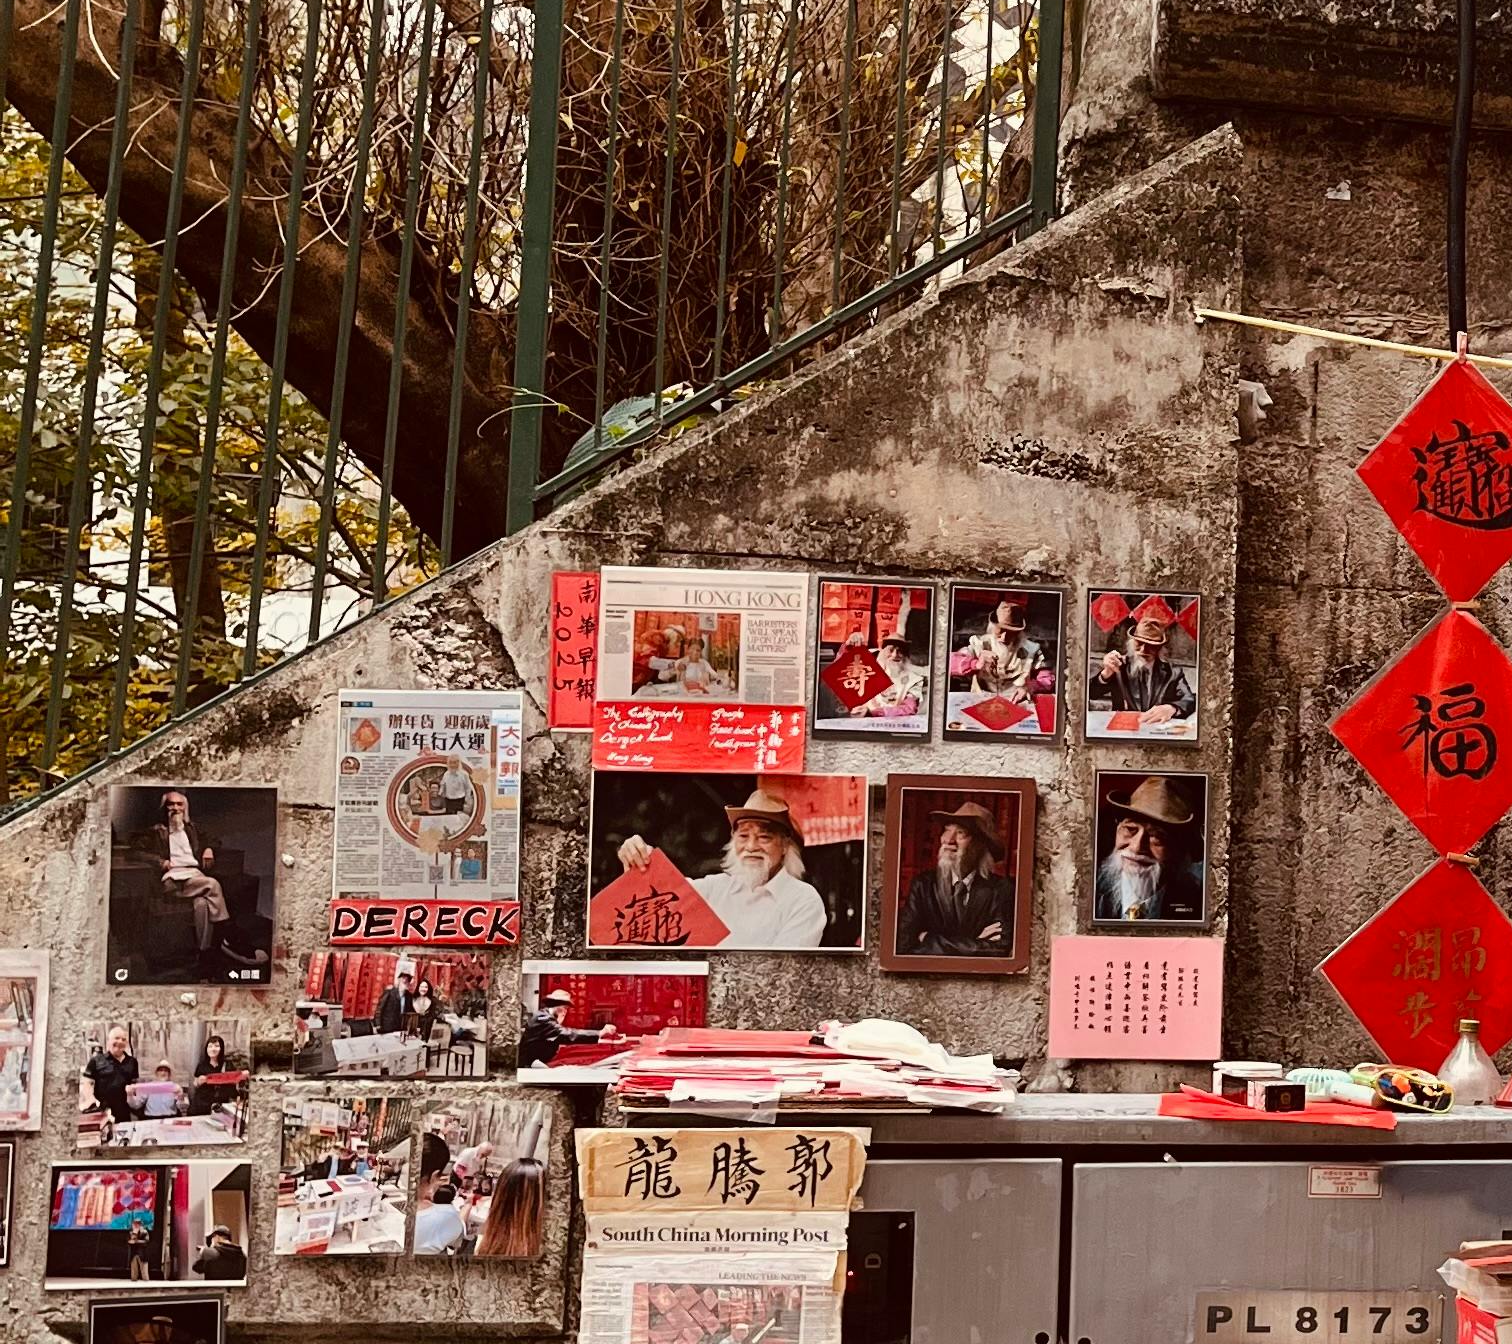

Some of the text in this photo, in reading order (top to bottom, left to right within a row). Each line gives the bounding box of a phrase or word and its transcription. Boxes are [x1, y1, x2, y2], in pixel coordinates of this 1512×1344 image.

[684, 589, 802, 608] HONG KONG
[392, 732, 486, 751] 龍年行大運
[1402, 682, 1498, 781] 福
[331, 904, 520, 944] DERECK
[601, 1226, 831, 1247] South China Morning Post
[717, 1271, 759, 1281] LEADING
[780, 1273, 808, 1282] NEWS
[1206, 1305, 1431, 1335] PL 8173
